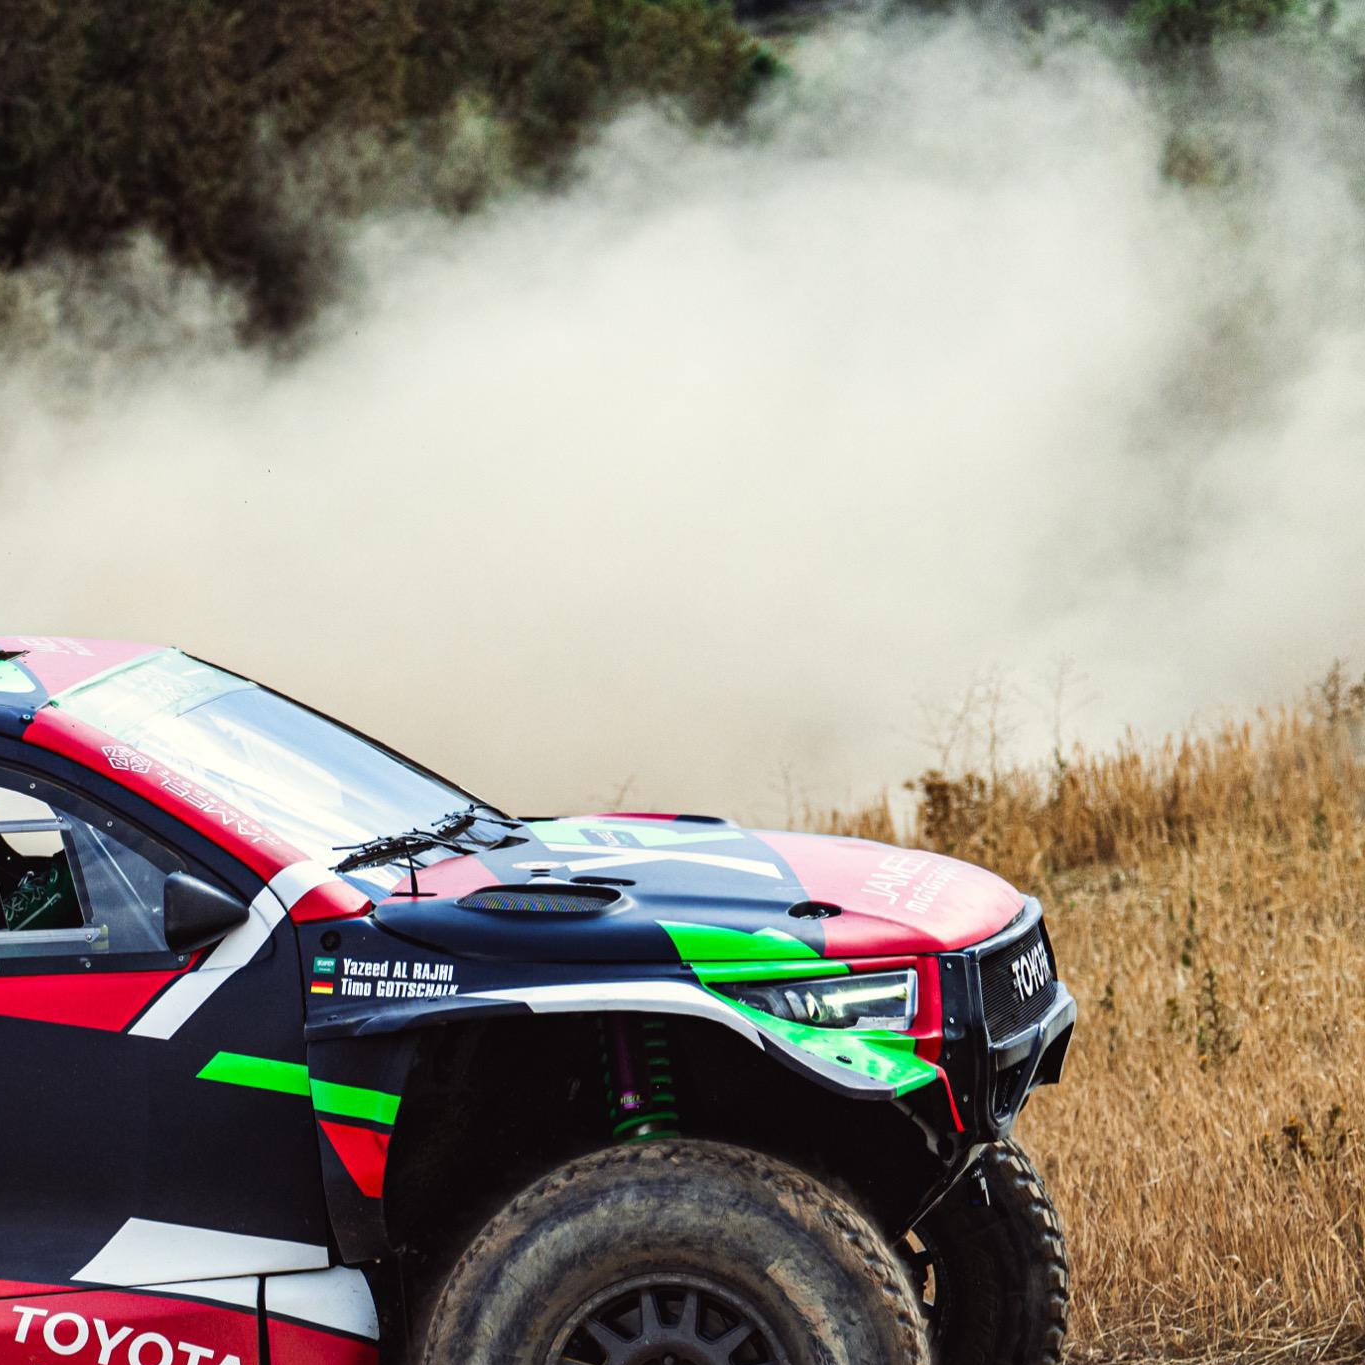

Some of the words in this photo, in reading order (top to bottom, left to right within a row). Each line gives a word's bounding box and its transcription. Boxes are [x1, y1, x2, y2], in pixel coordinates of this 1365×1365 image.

[157, 771, 281, 846] JAMEEL
[343, 958, 389, 977] Yazeed
[392, 961, 408, 979] AL
[412, 963, 454, 981] RAJHI
[341, 978, 372, 996] Timo
[376, 980, 459, 998] GOTTSCHALK
